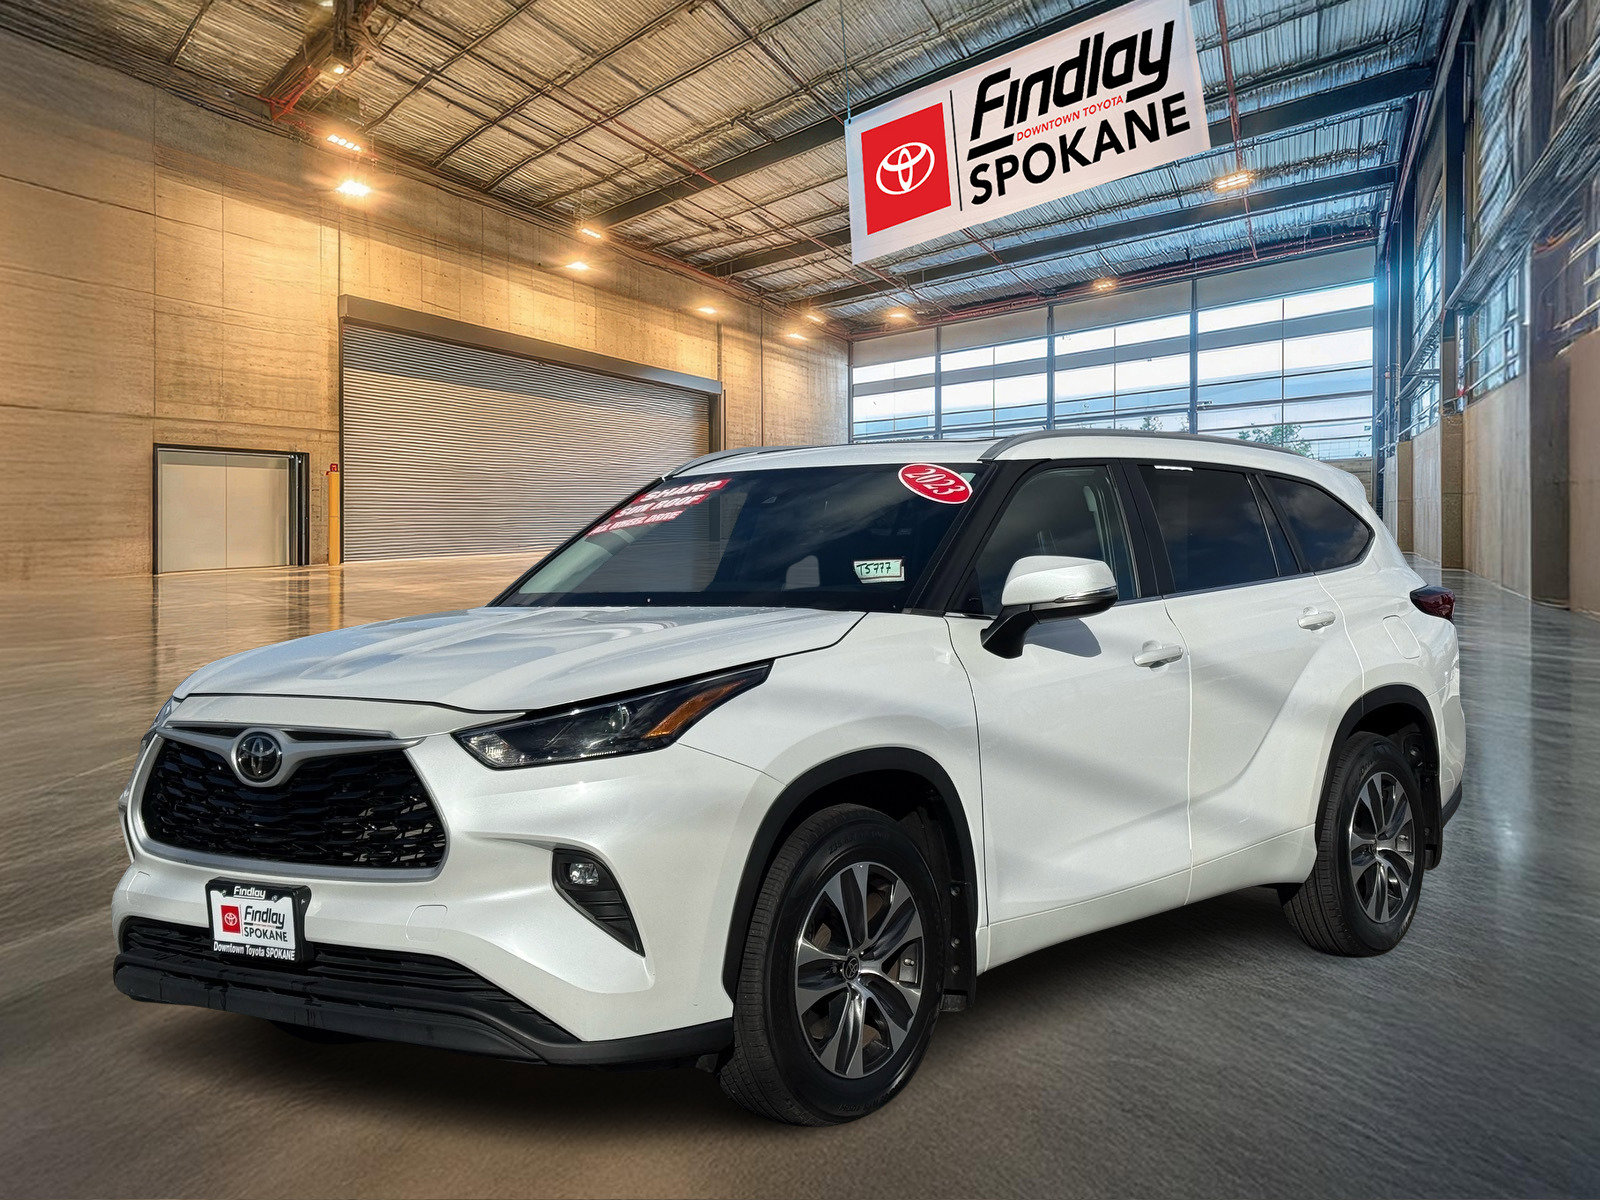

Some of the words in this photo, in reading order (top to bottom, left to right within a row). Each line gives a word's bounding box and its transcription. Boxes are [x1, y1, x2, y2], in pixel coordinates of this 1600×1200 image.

[969, 20, 1175, 143] Findlay
[1016, 111, 1080, 141] DOWNTOWN
[1082, 95, 1124, 118] TOYOTA
[968, 91, 1191, 205] SPOKANE
[640, 480, 722, 502] SHARP
[904, 468, 966, 495] 2023
[233, 886, 266, 899] Findlay
[244, 905, 285, 930] Findlay
[243, 926, 288, 942] SPOKANE
[213, 941, 245, 954] Downtown
[246, 945, 265, 957] Toyota
[266, 948, 296, 961] SPOKANE
